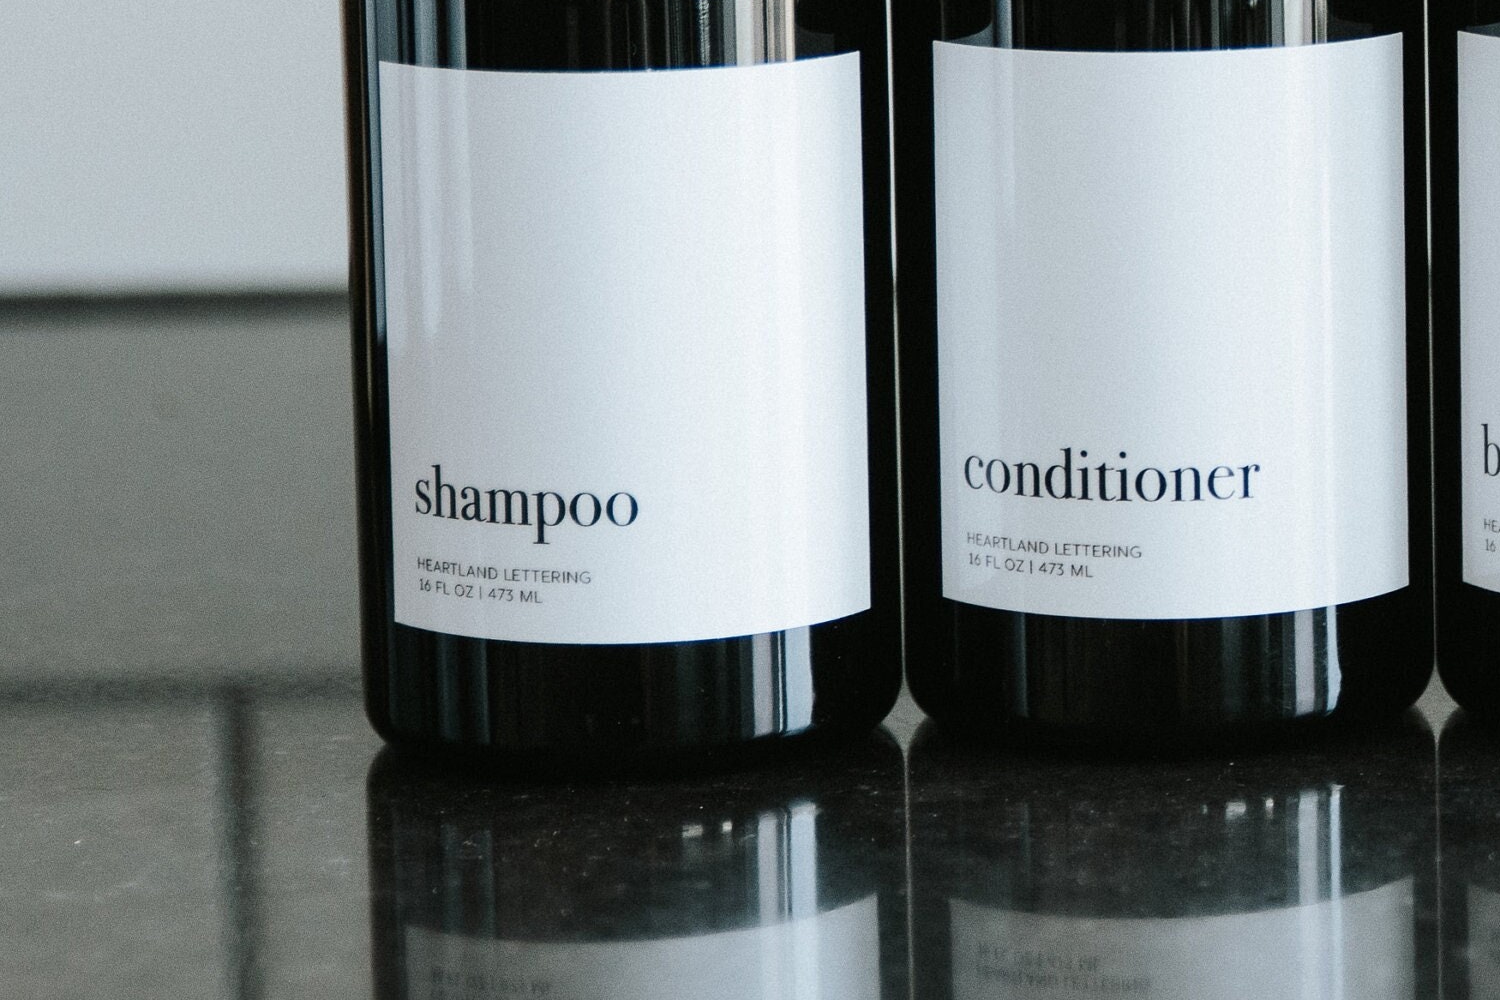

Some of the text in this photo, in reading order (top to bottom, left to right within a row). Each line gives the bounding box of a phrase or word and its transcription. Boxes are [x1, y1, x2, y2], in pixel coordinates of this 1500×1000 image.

[963, 446, 1261, 504] conditioner
[414, 463, 640, 547] shampoo
[967, 532, 1143, 559] HEARTLAND LETTERING
[1485, 538, 1496, 554] 16
[417, 557, 592, 585] HEARTLAND LETTERING
[968, 552, 981, 567] 16
[986, 555, 1001, 570] FL
[1004, 558, 1025, 573] OZ
[1039, 561, 1065, 577] 473
[1070, 564, 1094, 578] ML
[420, 578, 432, 593] 16
[436, 581, 451, 596] FL
[454, 584, 474, 599] OZ
[488, 587, 515, 603] 473
[520, 590, 543, 604] ML
